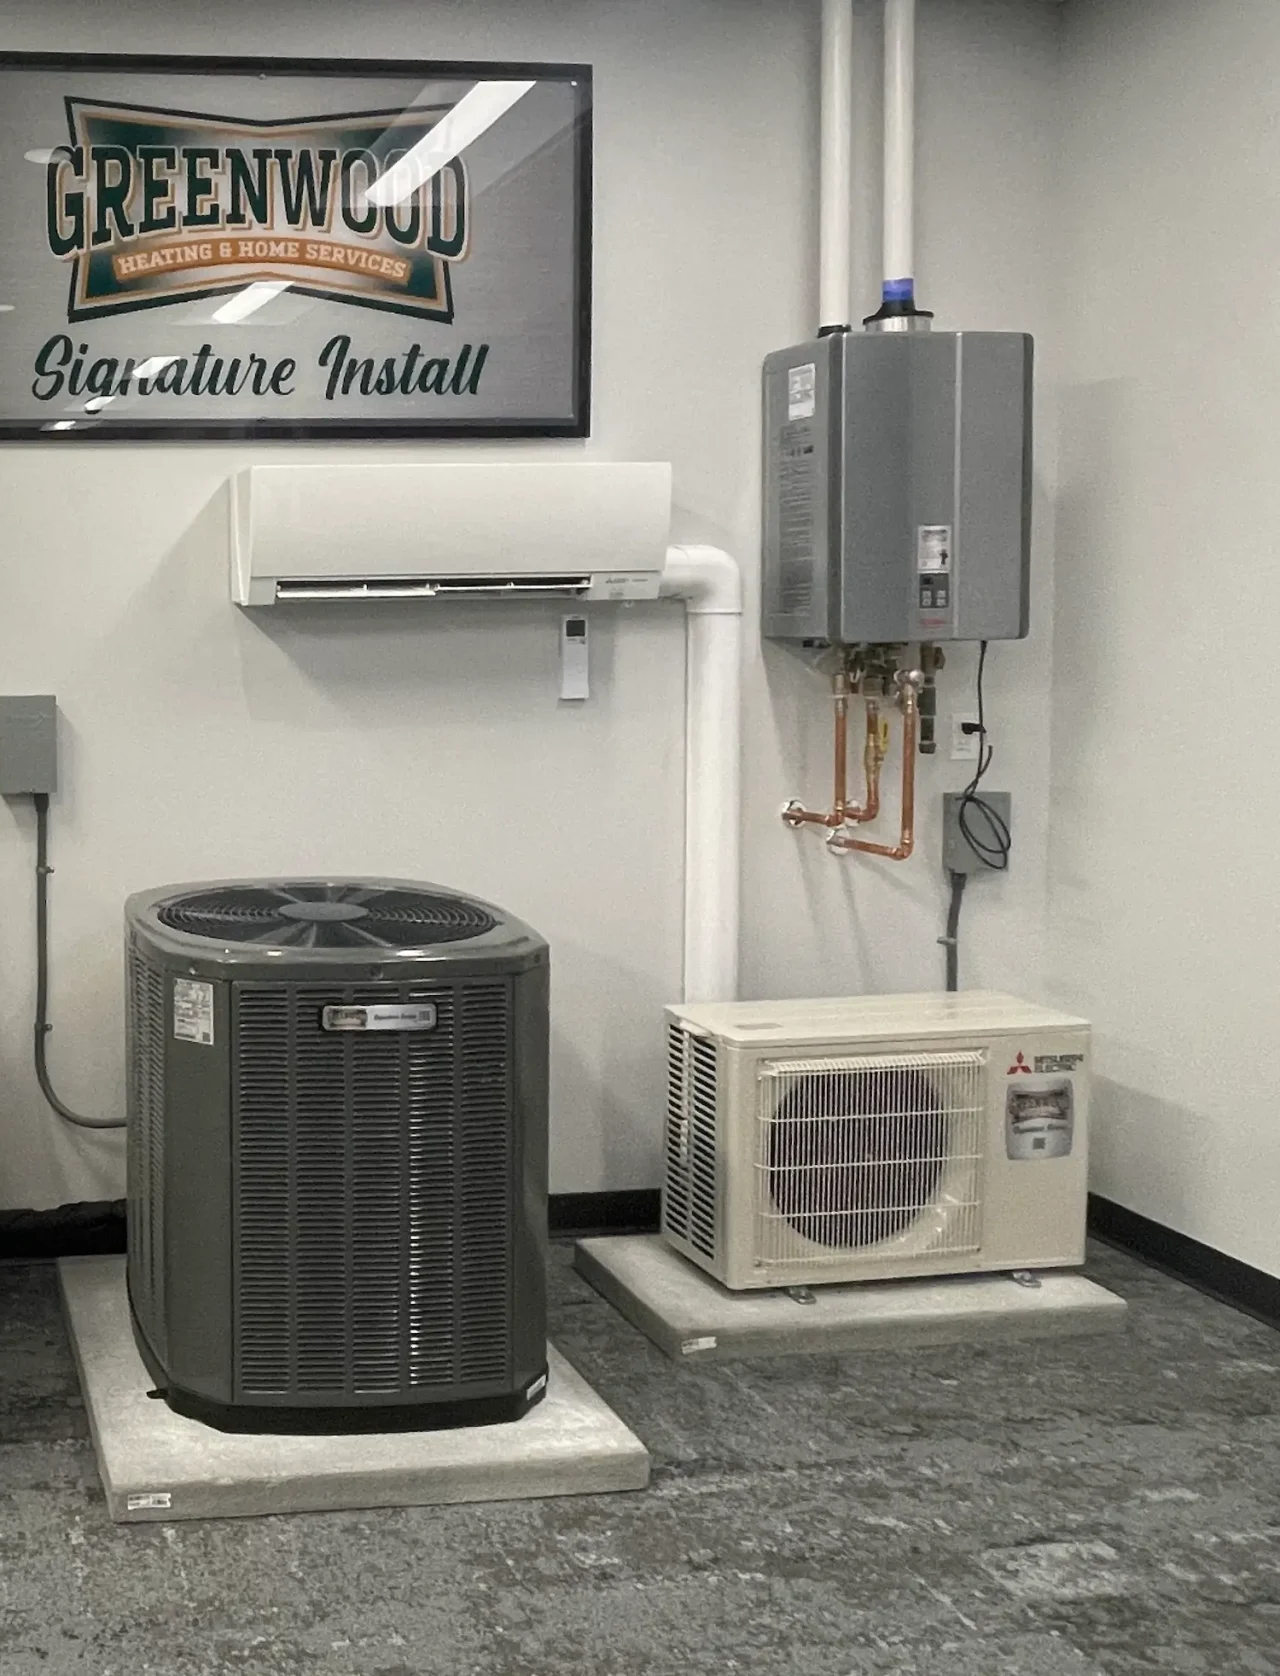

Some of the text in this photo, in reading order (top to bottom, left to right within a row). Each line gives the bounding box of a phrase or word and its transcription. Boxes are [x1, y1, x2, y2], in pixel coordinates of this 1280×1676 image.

[46, 145, 470, 261] GREENWOOD
[118, 240, 408, 279] HEATING & HOME SERVICES
[31, 334, 490, 414] Signature Install
